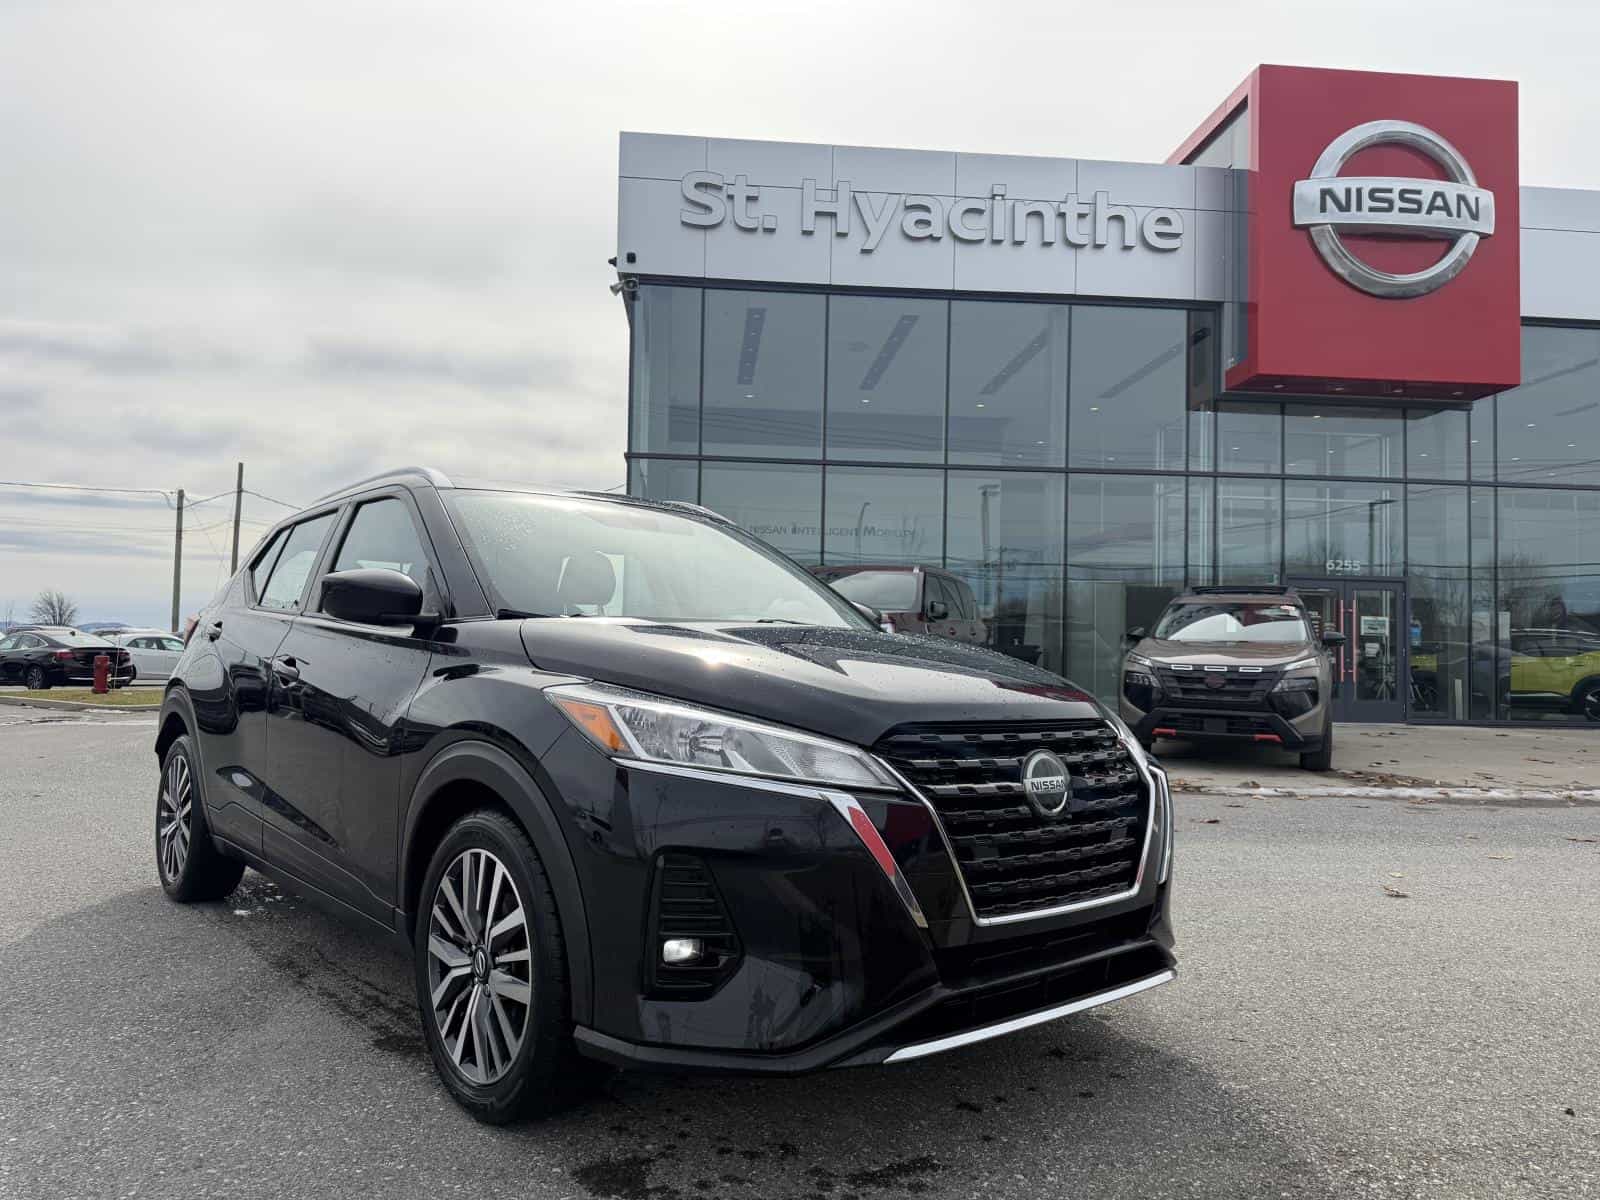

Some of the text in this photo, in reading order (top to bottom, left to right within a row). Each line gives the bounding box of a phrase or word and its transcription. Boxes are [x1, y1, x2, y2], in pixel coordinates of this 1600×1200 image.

[680, 170, 1184, 254] St. Hyacinthe
[1319, 187, 1481, 222] NISSAN
[1326, 559, 1361, 571] 6255
